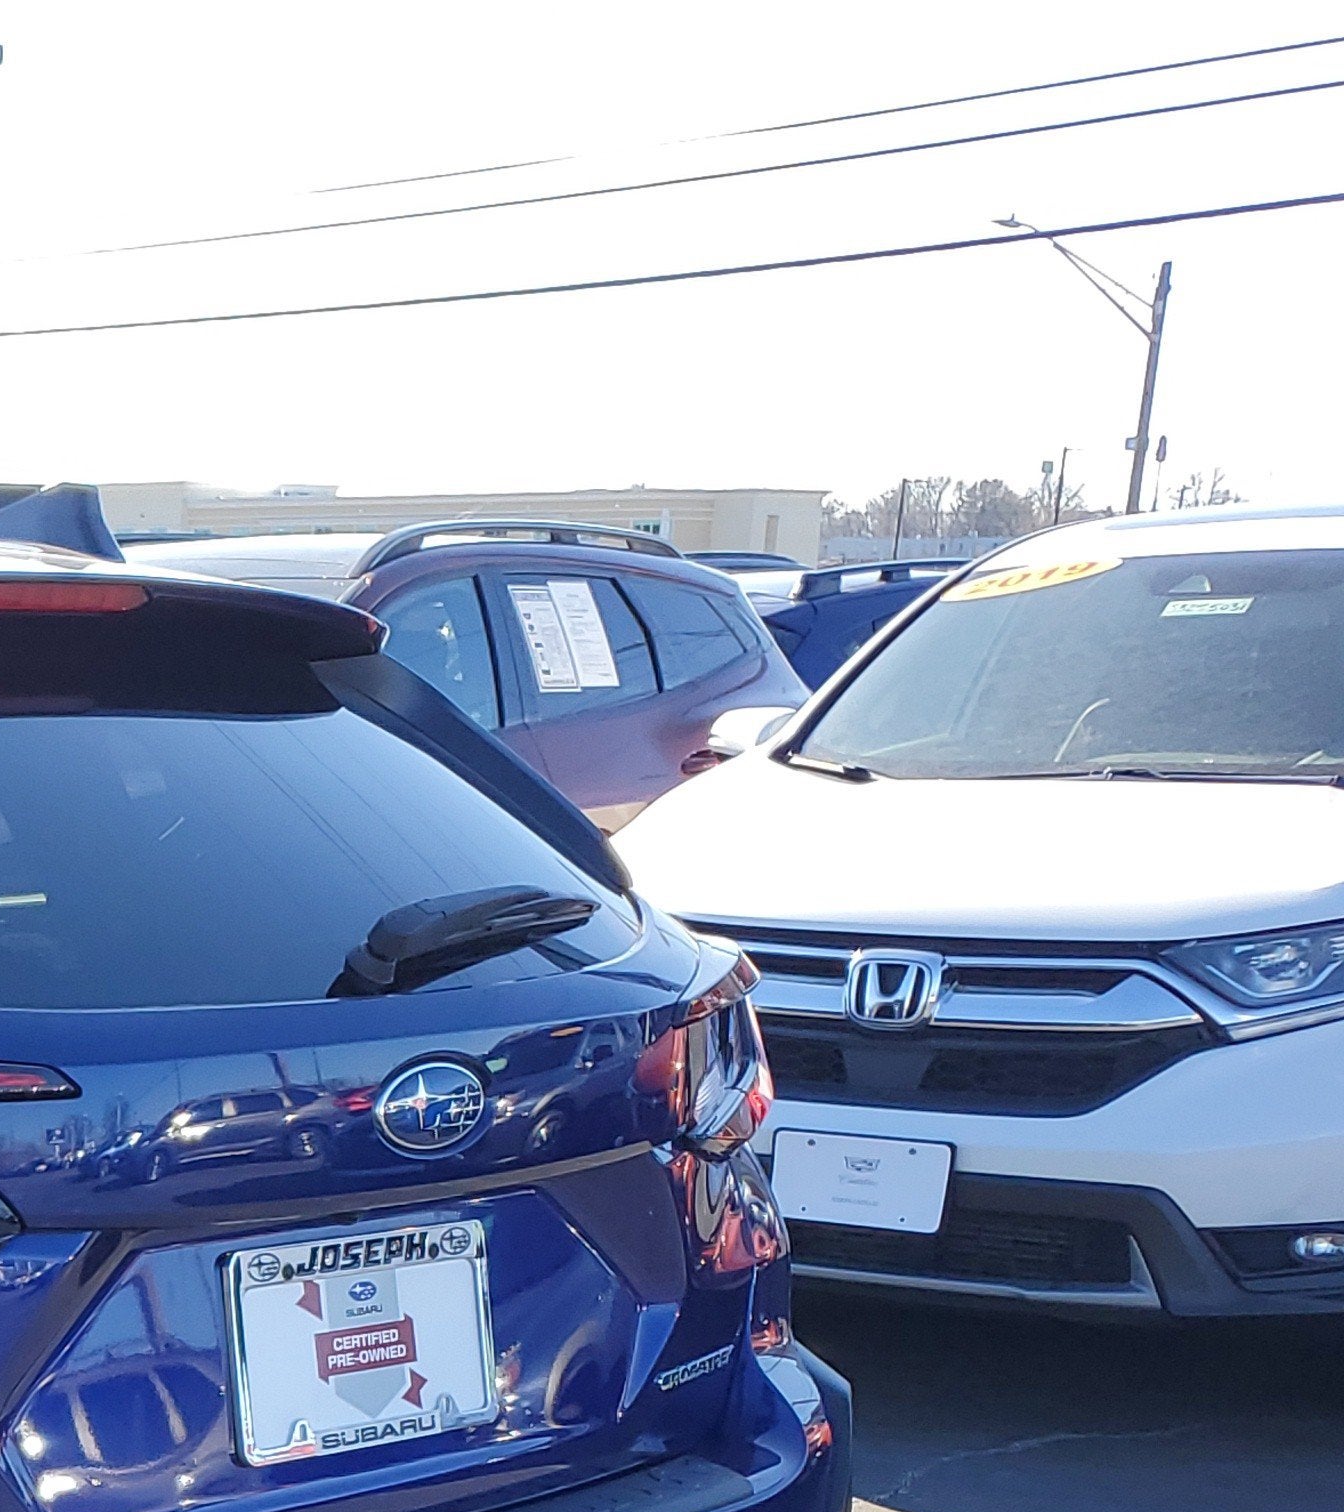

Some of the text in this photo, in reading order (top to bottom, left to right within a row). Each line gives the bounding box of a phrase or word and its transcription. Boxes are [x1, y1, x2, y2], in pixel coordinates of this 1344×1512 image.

[964, 561, 1099, 596] 2019
[294, 1231, 429, 1276] JOSEPH
[345, 1303, 384, 1318] SUBARU
[333, 1328, 400, 1351] CERTIFIED
[327, 1344, 407, 1370] PRE-OWNED
[320, 1413, 437, 1450] SUBARU
